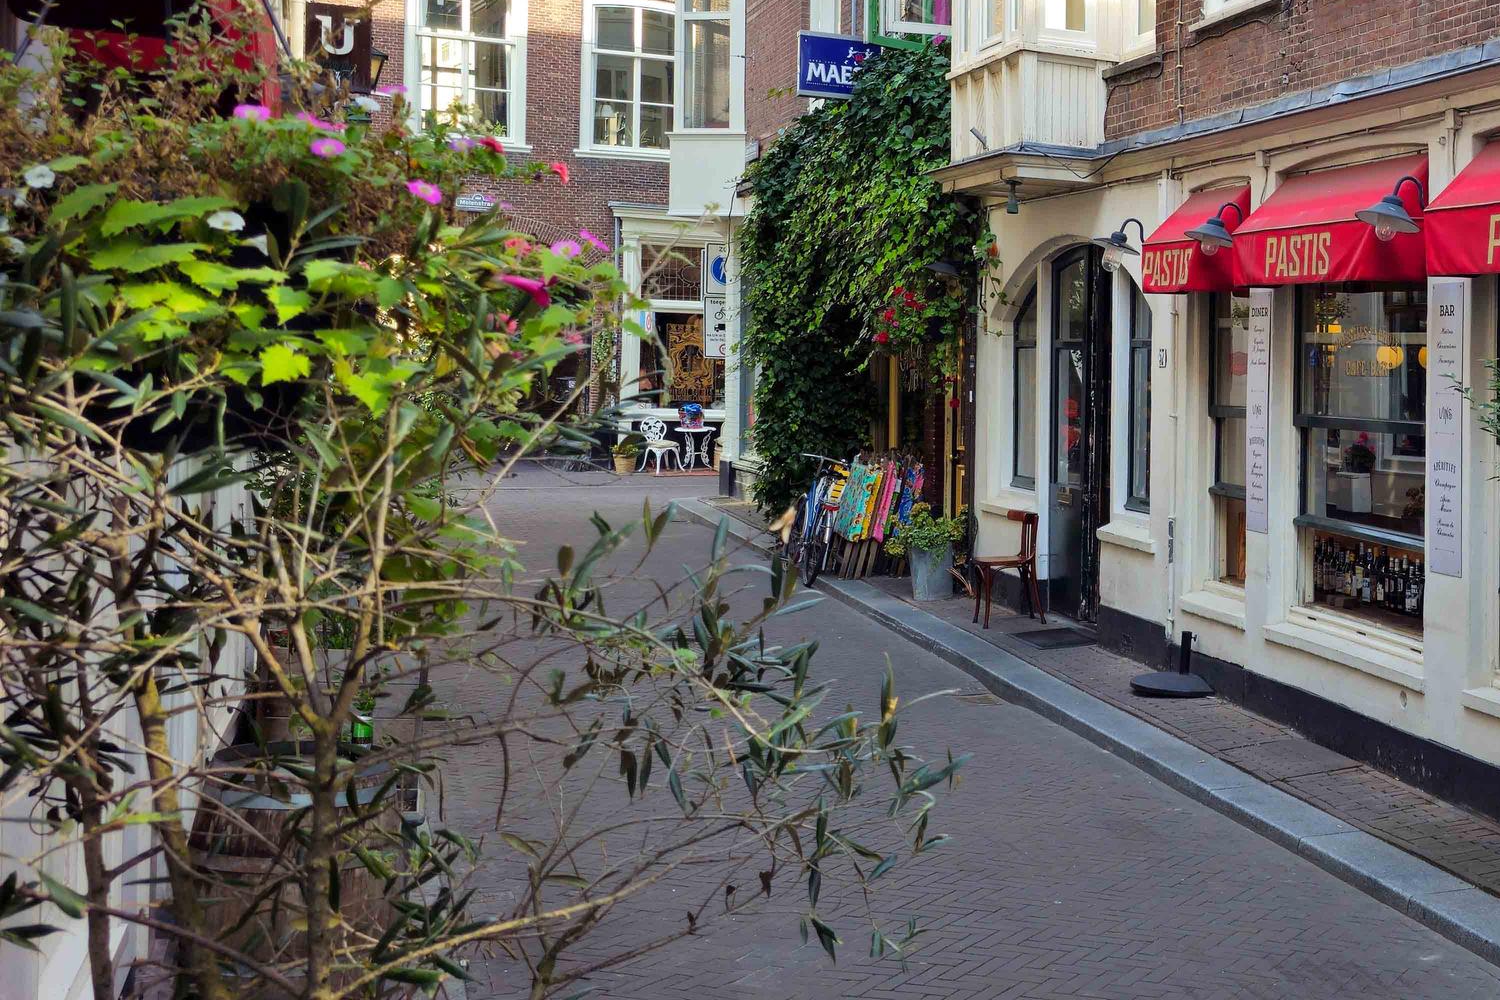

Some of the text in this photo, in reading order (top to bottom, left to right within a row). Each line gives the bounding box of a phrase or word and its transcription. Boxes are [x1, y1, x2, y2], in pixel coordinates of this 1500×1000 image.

[806, 61, 862, 84] MAE
[459, 199, 495, 207] Molenstraa
[1265, 231, 1331, 278] PASTIS
[1251, 307, 1269, 318] DINER
[1439, 304, 1455, 317] BAR
